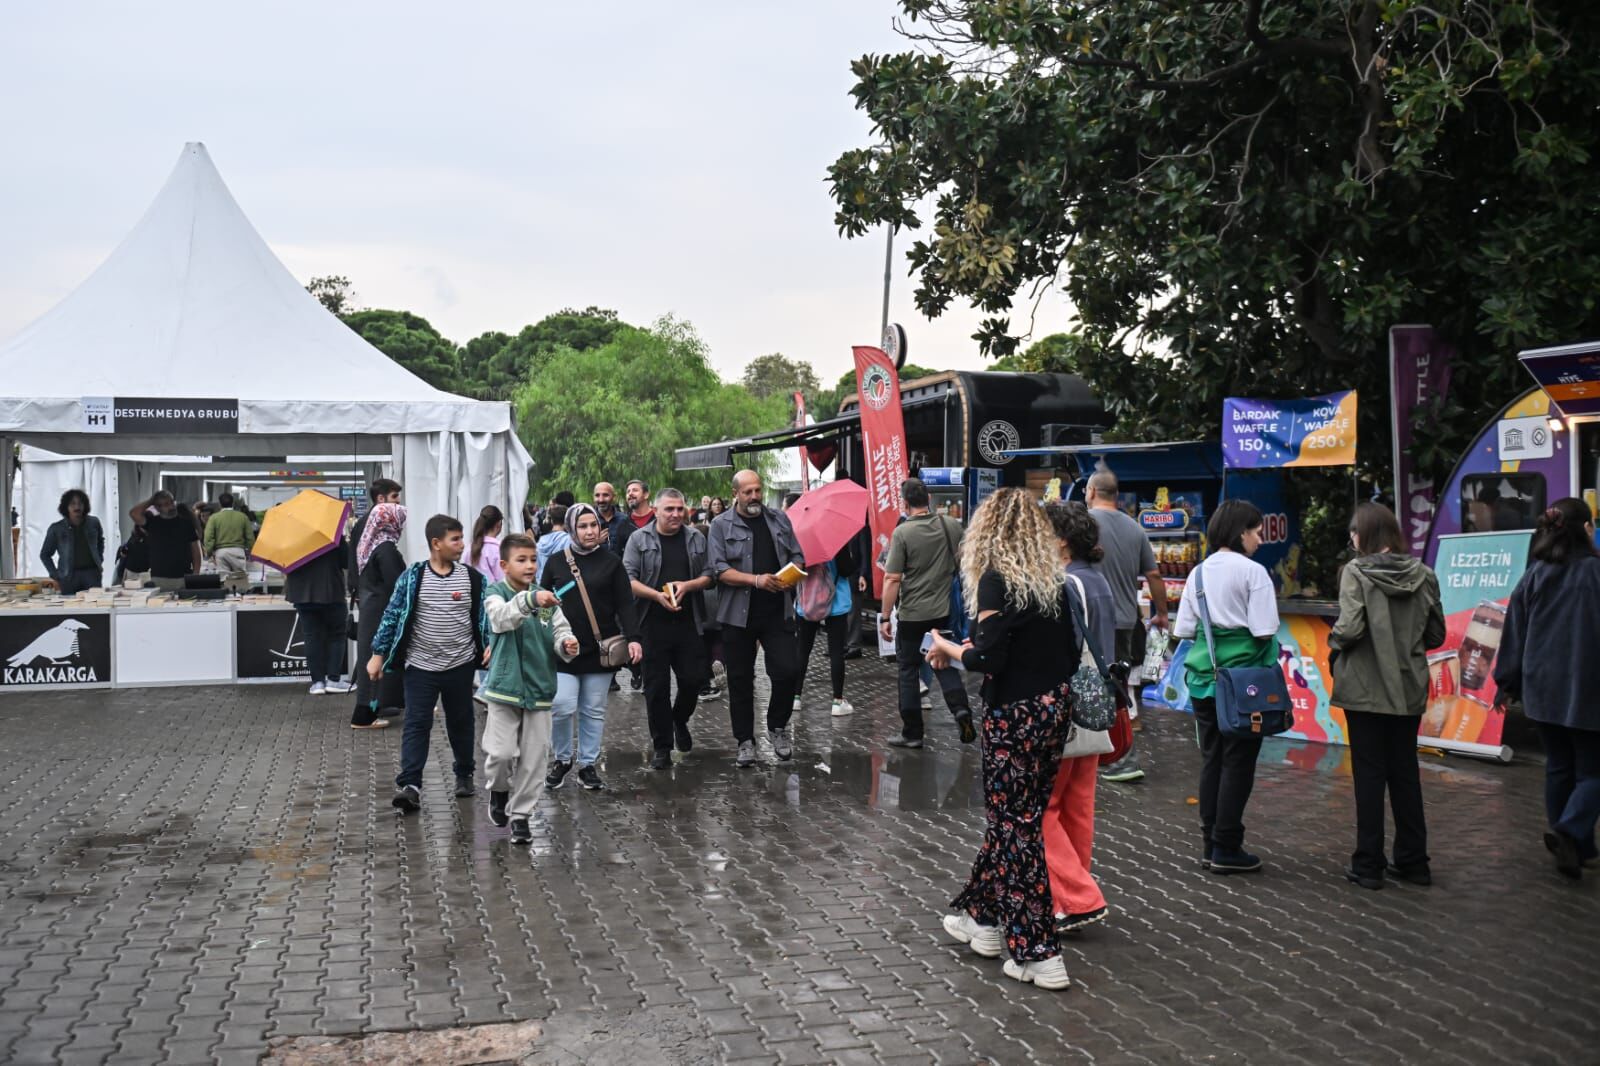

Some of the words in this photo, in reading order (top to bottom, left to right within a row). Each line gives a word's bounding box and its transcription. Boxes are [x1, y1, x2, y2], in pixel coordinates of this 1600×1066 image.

[114, 409, 155, 418] DESTEK
[156, 409, 196, 418] MEDYA
[198, 409, 238, 419] GRUBU
[1233, 409, 1281, 420] BARDAK
[1312, 405, 1343, 419] KOVA
[88, 415, 107, 425] H1
[1304, 418, 1350, 431] WAFFLE
[1233, 423, 1278, 434] WAFFLE
[1143, 514, 1174, 524] HARIBO
[1261, 513, 1287, 544] IBO
[1450, 549, 1511, 567] LEZZETİN
[1447, 570, 1477, 588] YENİ
[1479, 570, 1511, 588] HALİ
[272, 660, 308, 669] DESTE
[1464, 648, 1482, 680] HYPE
[3, 666, 98, 684] KARAKARGA
